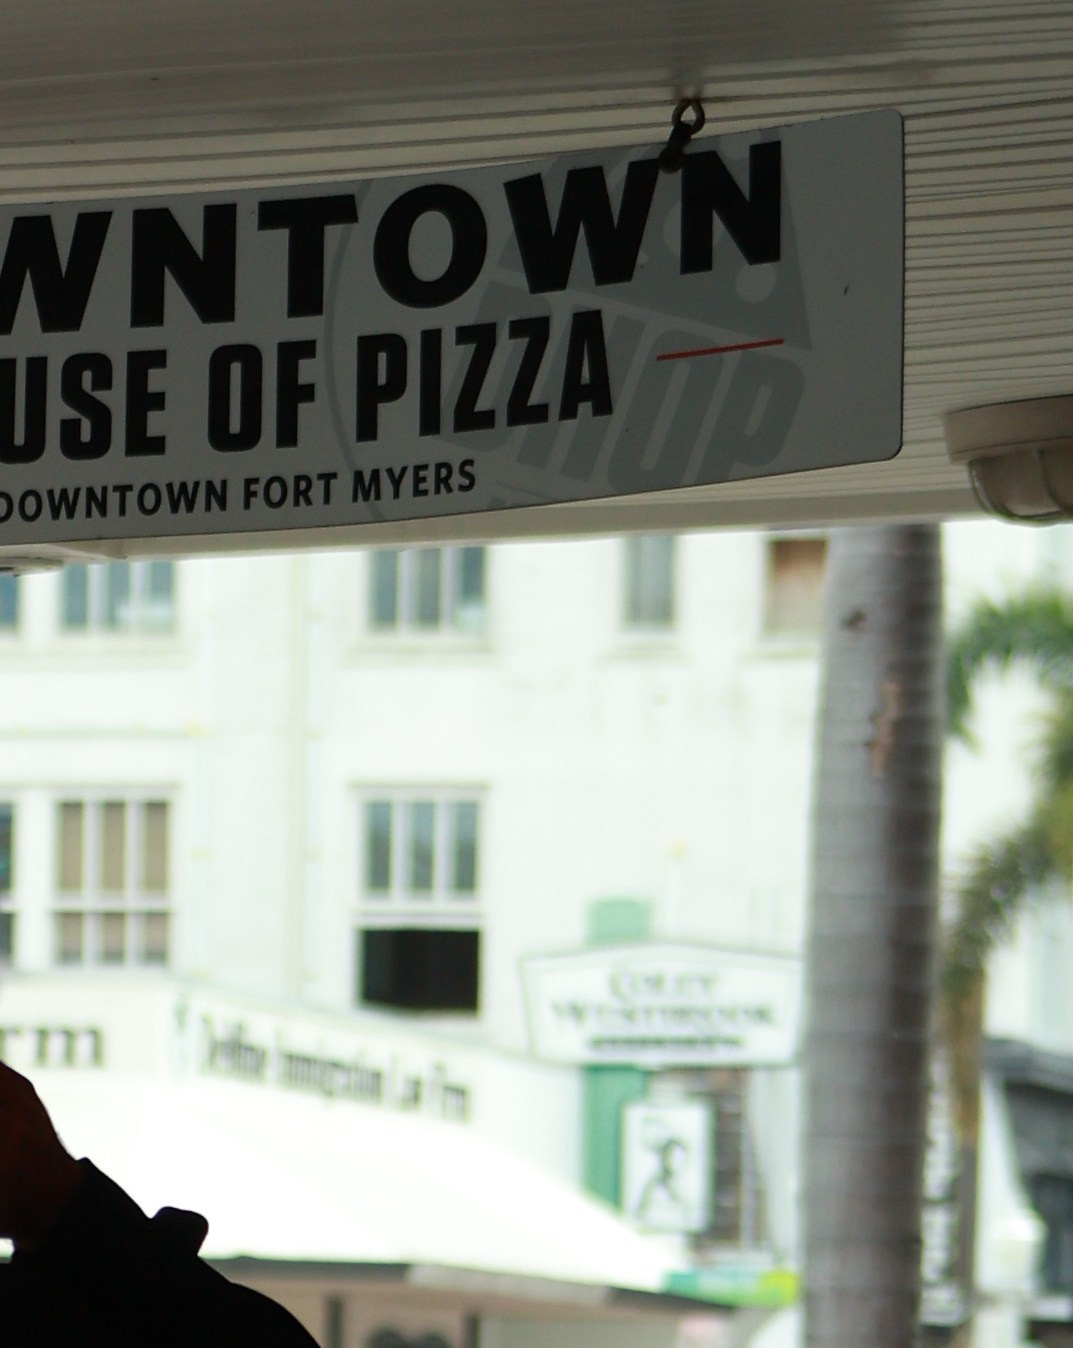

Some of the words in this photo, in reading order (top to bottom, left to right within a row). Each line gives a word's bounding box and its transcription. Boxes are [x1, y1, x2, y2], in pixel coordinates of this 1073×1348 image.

[207, 338, 318, 453] OF
[355, 308, 614, 443] PIZZA
[243, 471, 339, 511] FORT
[351, 458, 476, 504] MYERS
